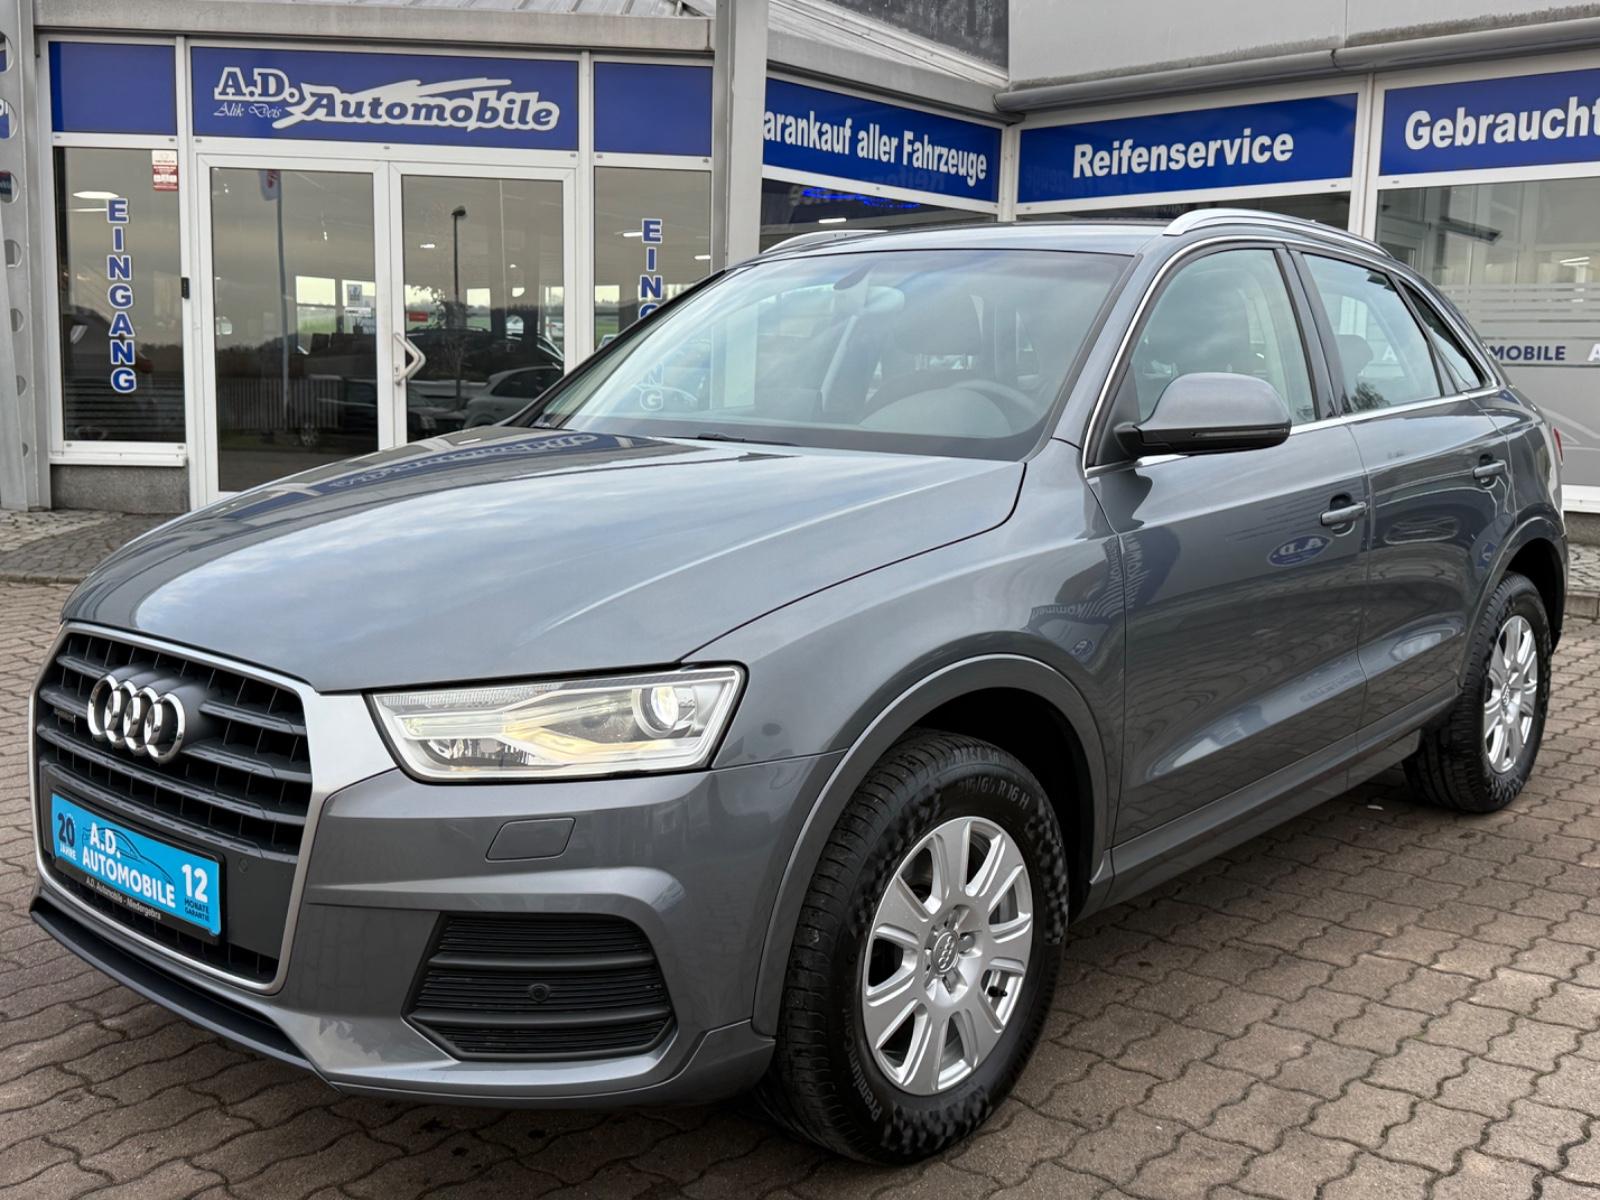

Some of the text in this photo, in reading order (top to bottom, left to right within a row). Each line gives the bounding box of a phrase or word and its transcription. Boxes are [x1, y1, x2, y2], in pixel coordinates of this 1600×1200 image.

[214, 67, 561, 132] A.D. Automobile
[857, 123, 899, 163] aller
[903, 130, 987, 187] Fahrzeuge
[1072, 128, 1294, 178] Reifenservice
[107, 198, 137, 393] EINGANG
[1008, 783, 1020, 802] 16
[1019, 792, 1030, 811] H
[57, 811, 75, 847] 20
[90, 822, 121, 858] A.D.
[83, 846, 176, 908] AUTOMOBILE
[181, 864, 208, 903] 12
